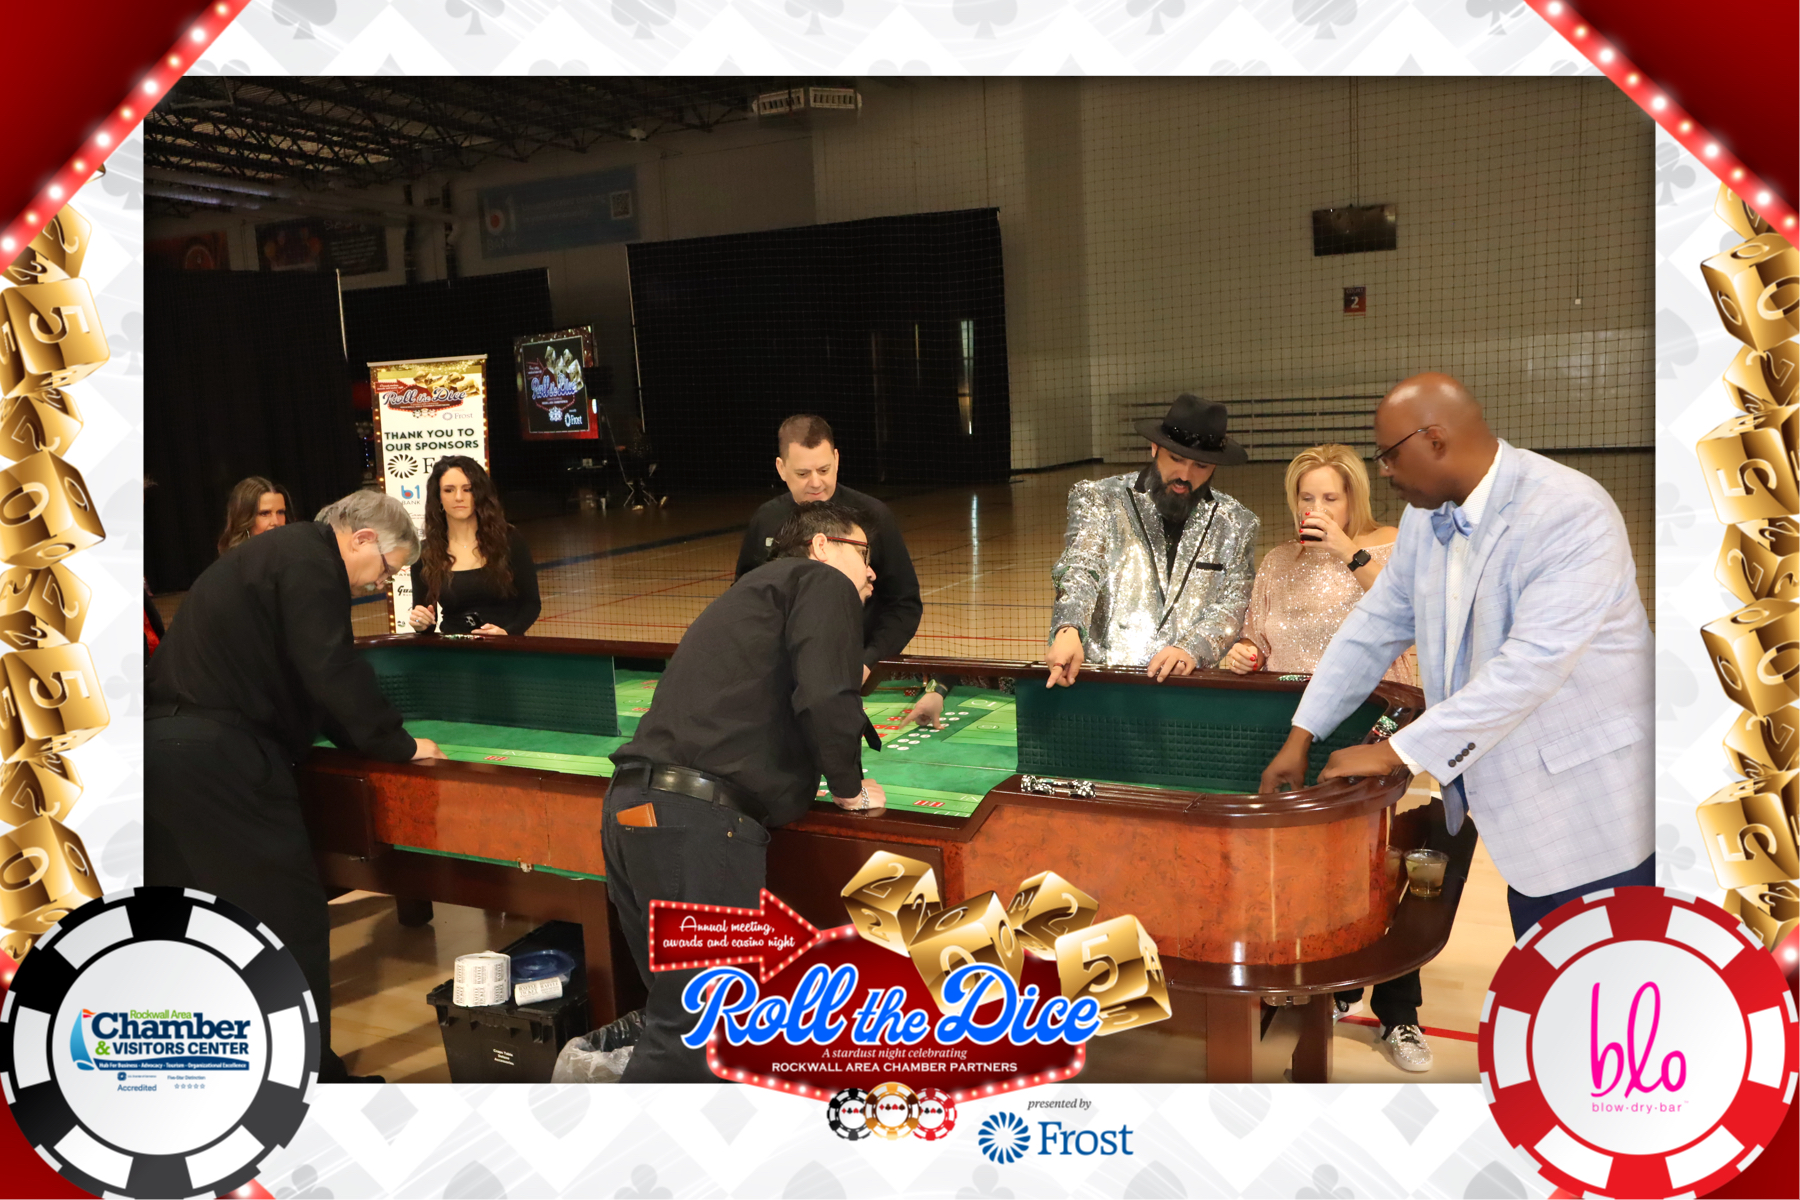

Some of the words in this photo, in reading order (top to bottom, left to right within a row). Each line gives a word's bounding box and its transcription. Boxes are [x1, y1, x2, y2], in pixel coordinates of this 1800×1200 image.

[1351, 296, 1360, 309] 2
[383, 389, 418, 406] Roll
[417, 393, 431, 403] the
[433, 388, 466, 402] Dice
[571, 416, 583, 426] Frost
[385, 431, 423, 440] THANK
[427, 429, 453, 439] YOU
[458, 428, 475, 437] TO
[386, 443, 411, 452] OUR
[416, 440, 479, 451] SPONSORS
[401, 485, 421, 500] b1
